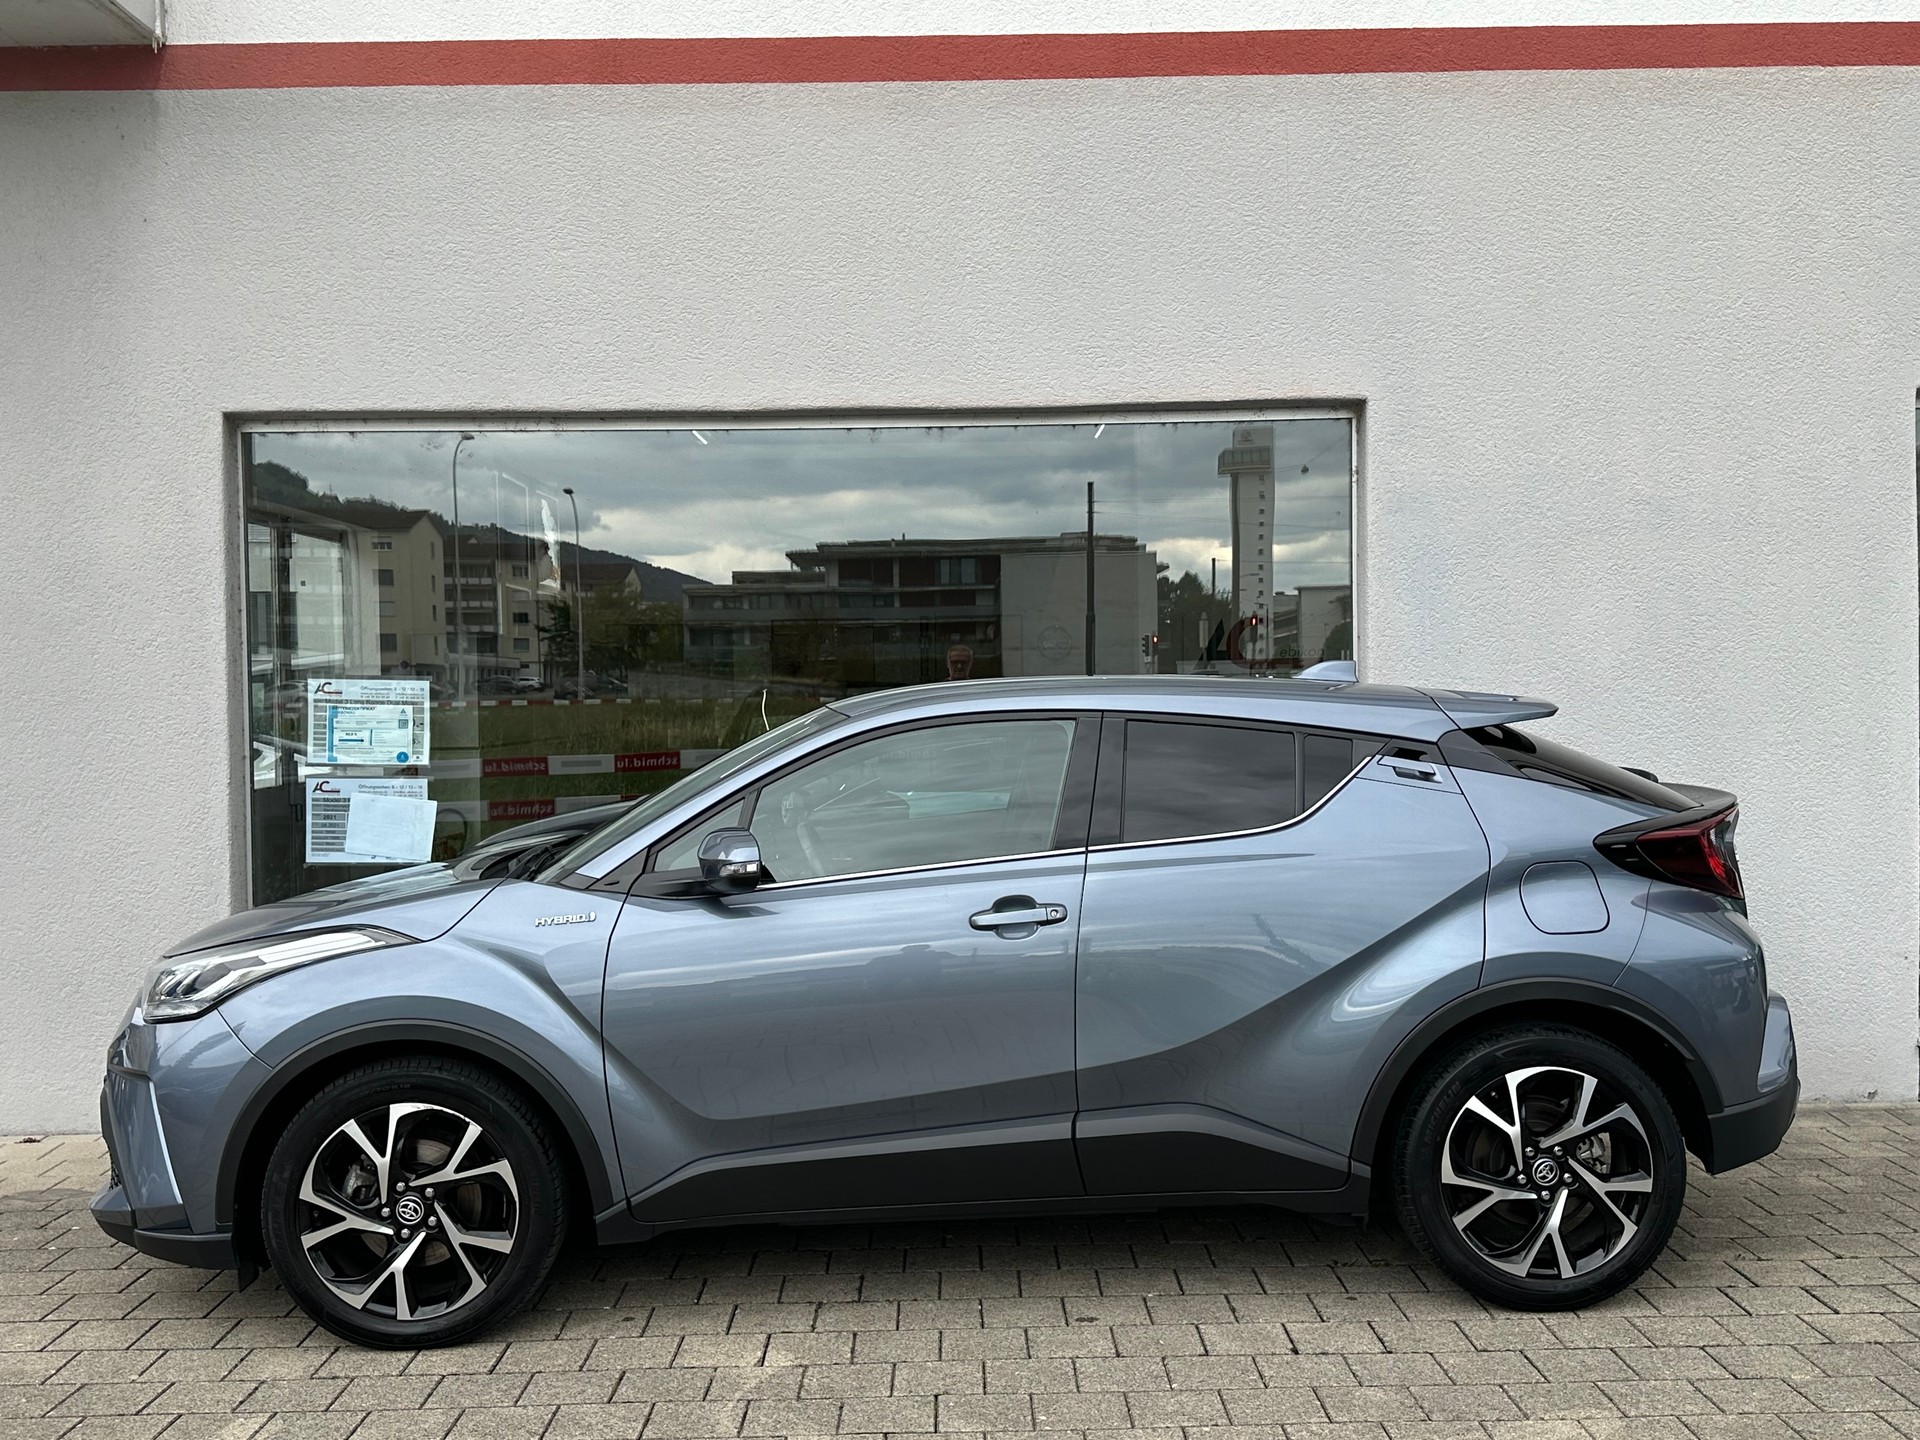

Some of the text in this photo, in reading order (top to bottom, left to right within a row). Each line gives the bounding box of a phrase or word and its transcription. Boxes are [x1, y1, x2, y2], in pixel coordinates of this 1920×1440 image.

[1280, 645, 1325, 657] ebikon
[314, 681, 343, 695] AC
[312, 781, 340, 793] AC
[535, 913, 586, 927] HYBRID
